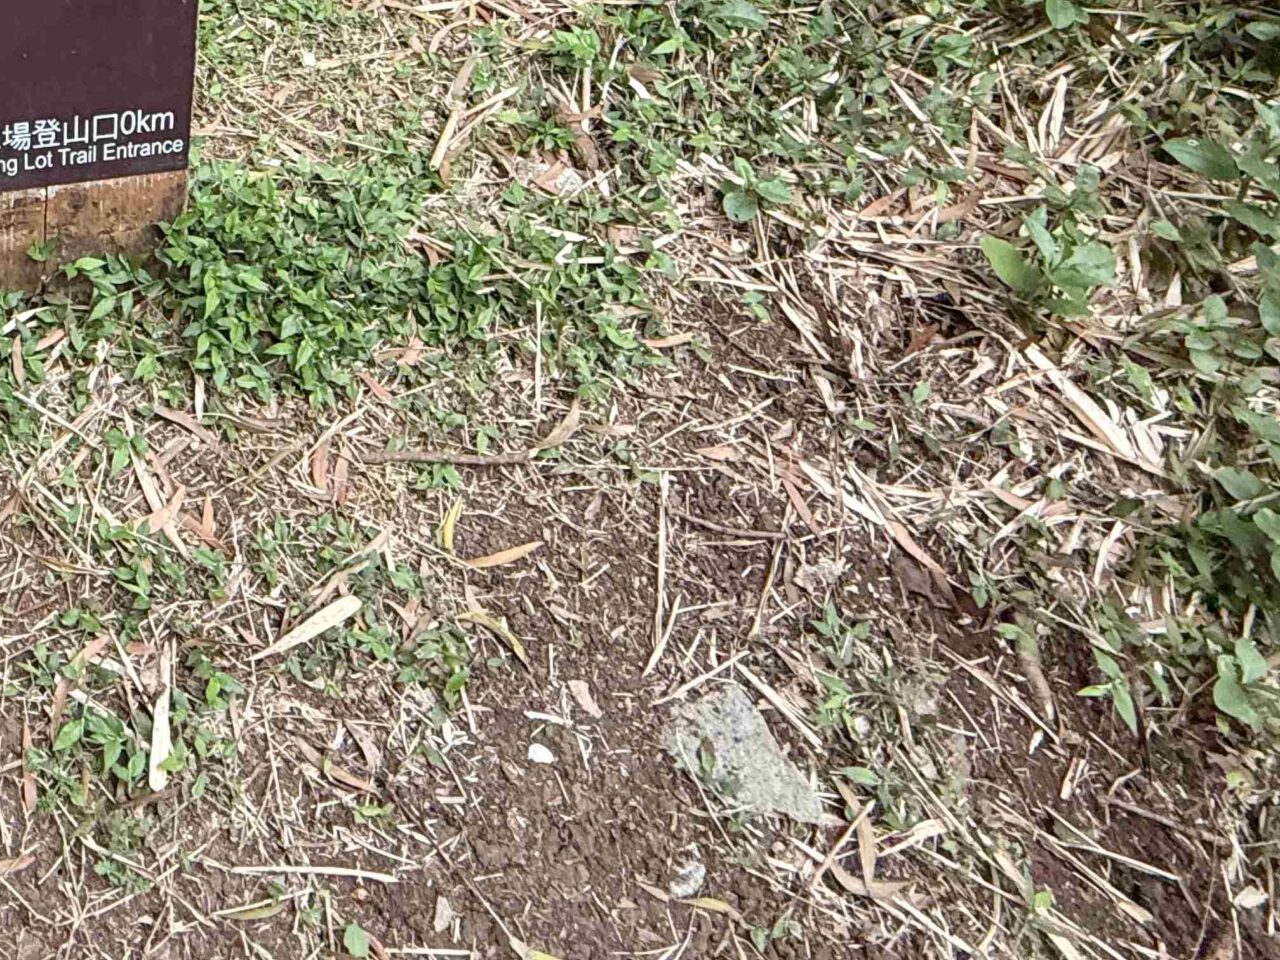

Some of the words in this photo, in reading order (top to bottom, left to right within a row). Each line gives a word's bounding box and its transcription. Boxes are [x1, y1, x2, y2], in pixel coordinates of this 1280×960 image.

[24, 151, 54, 171] Lot
[57, 145, 98, 167] Trail
[102, 137, 184, 161] Entrance
